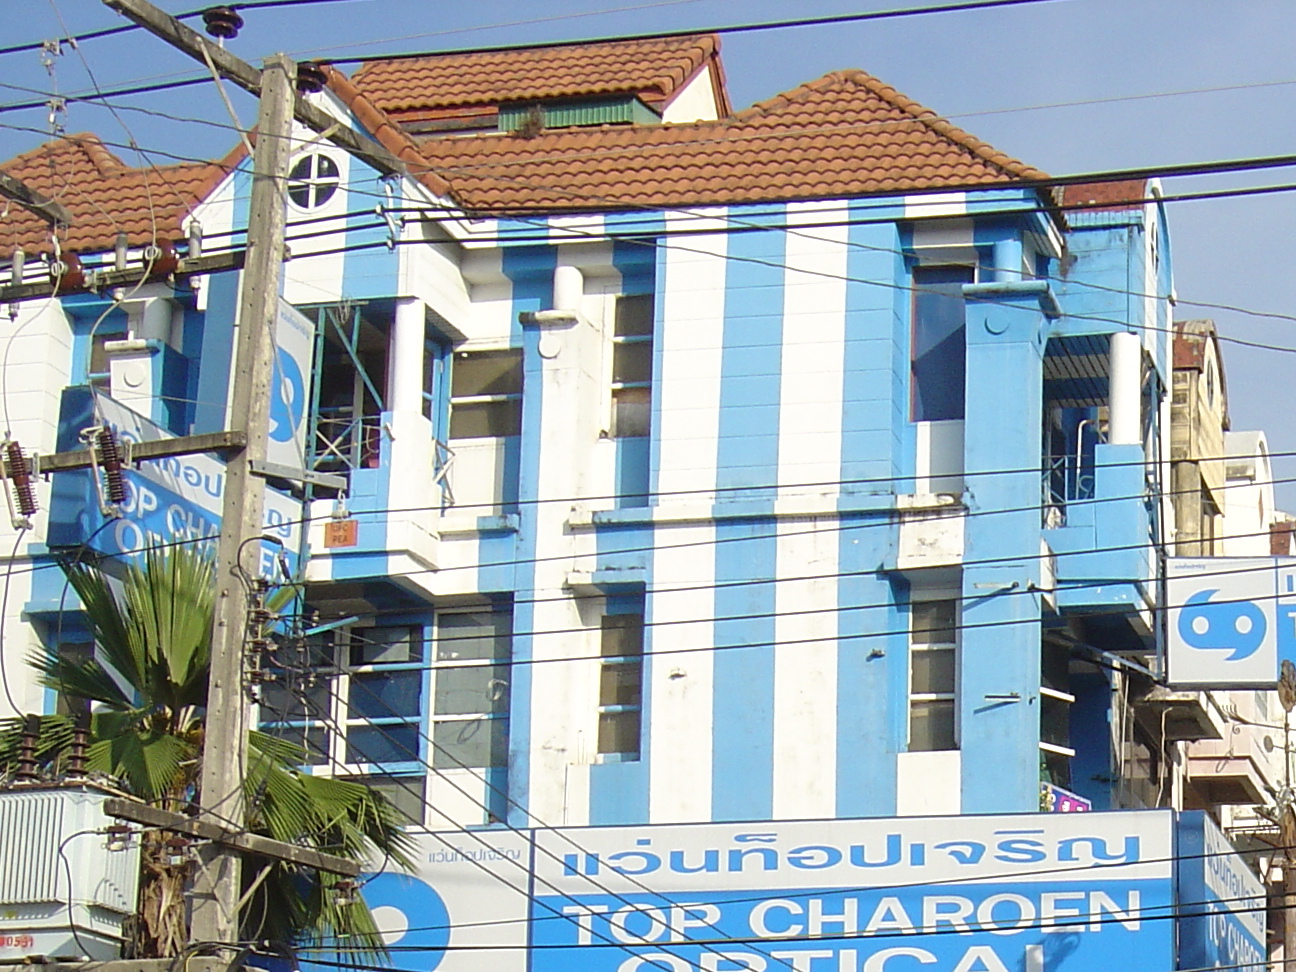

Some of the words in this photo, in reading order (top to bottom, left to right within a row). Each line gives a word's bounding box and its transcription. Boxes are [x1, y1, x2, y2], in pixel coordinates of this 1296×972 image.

[121, 480, 158, 518] OP
[563, 830, 1141, 877] แว่นท็อปเจริญ
[562, 903, 721, 945] TOP
[749, 890, 1141, 938] CHAROEN
[1208, 900, 1227, 946] TOP
